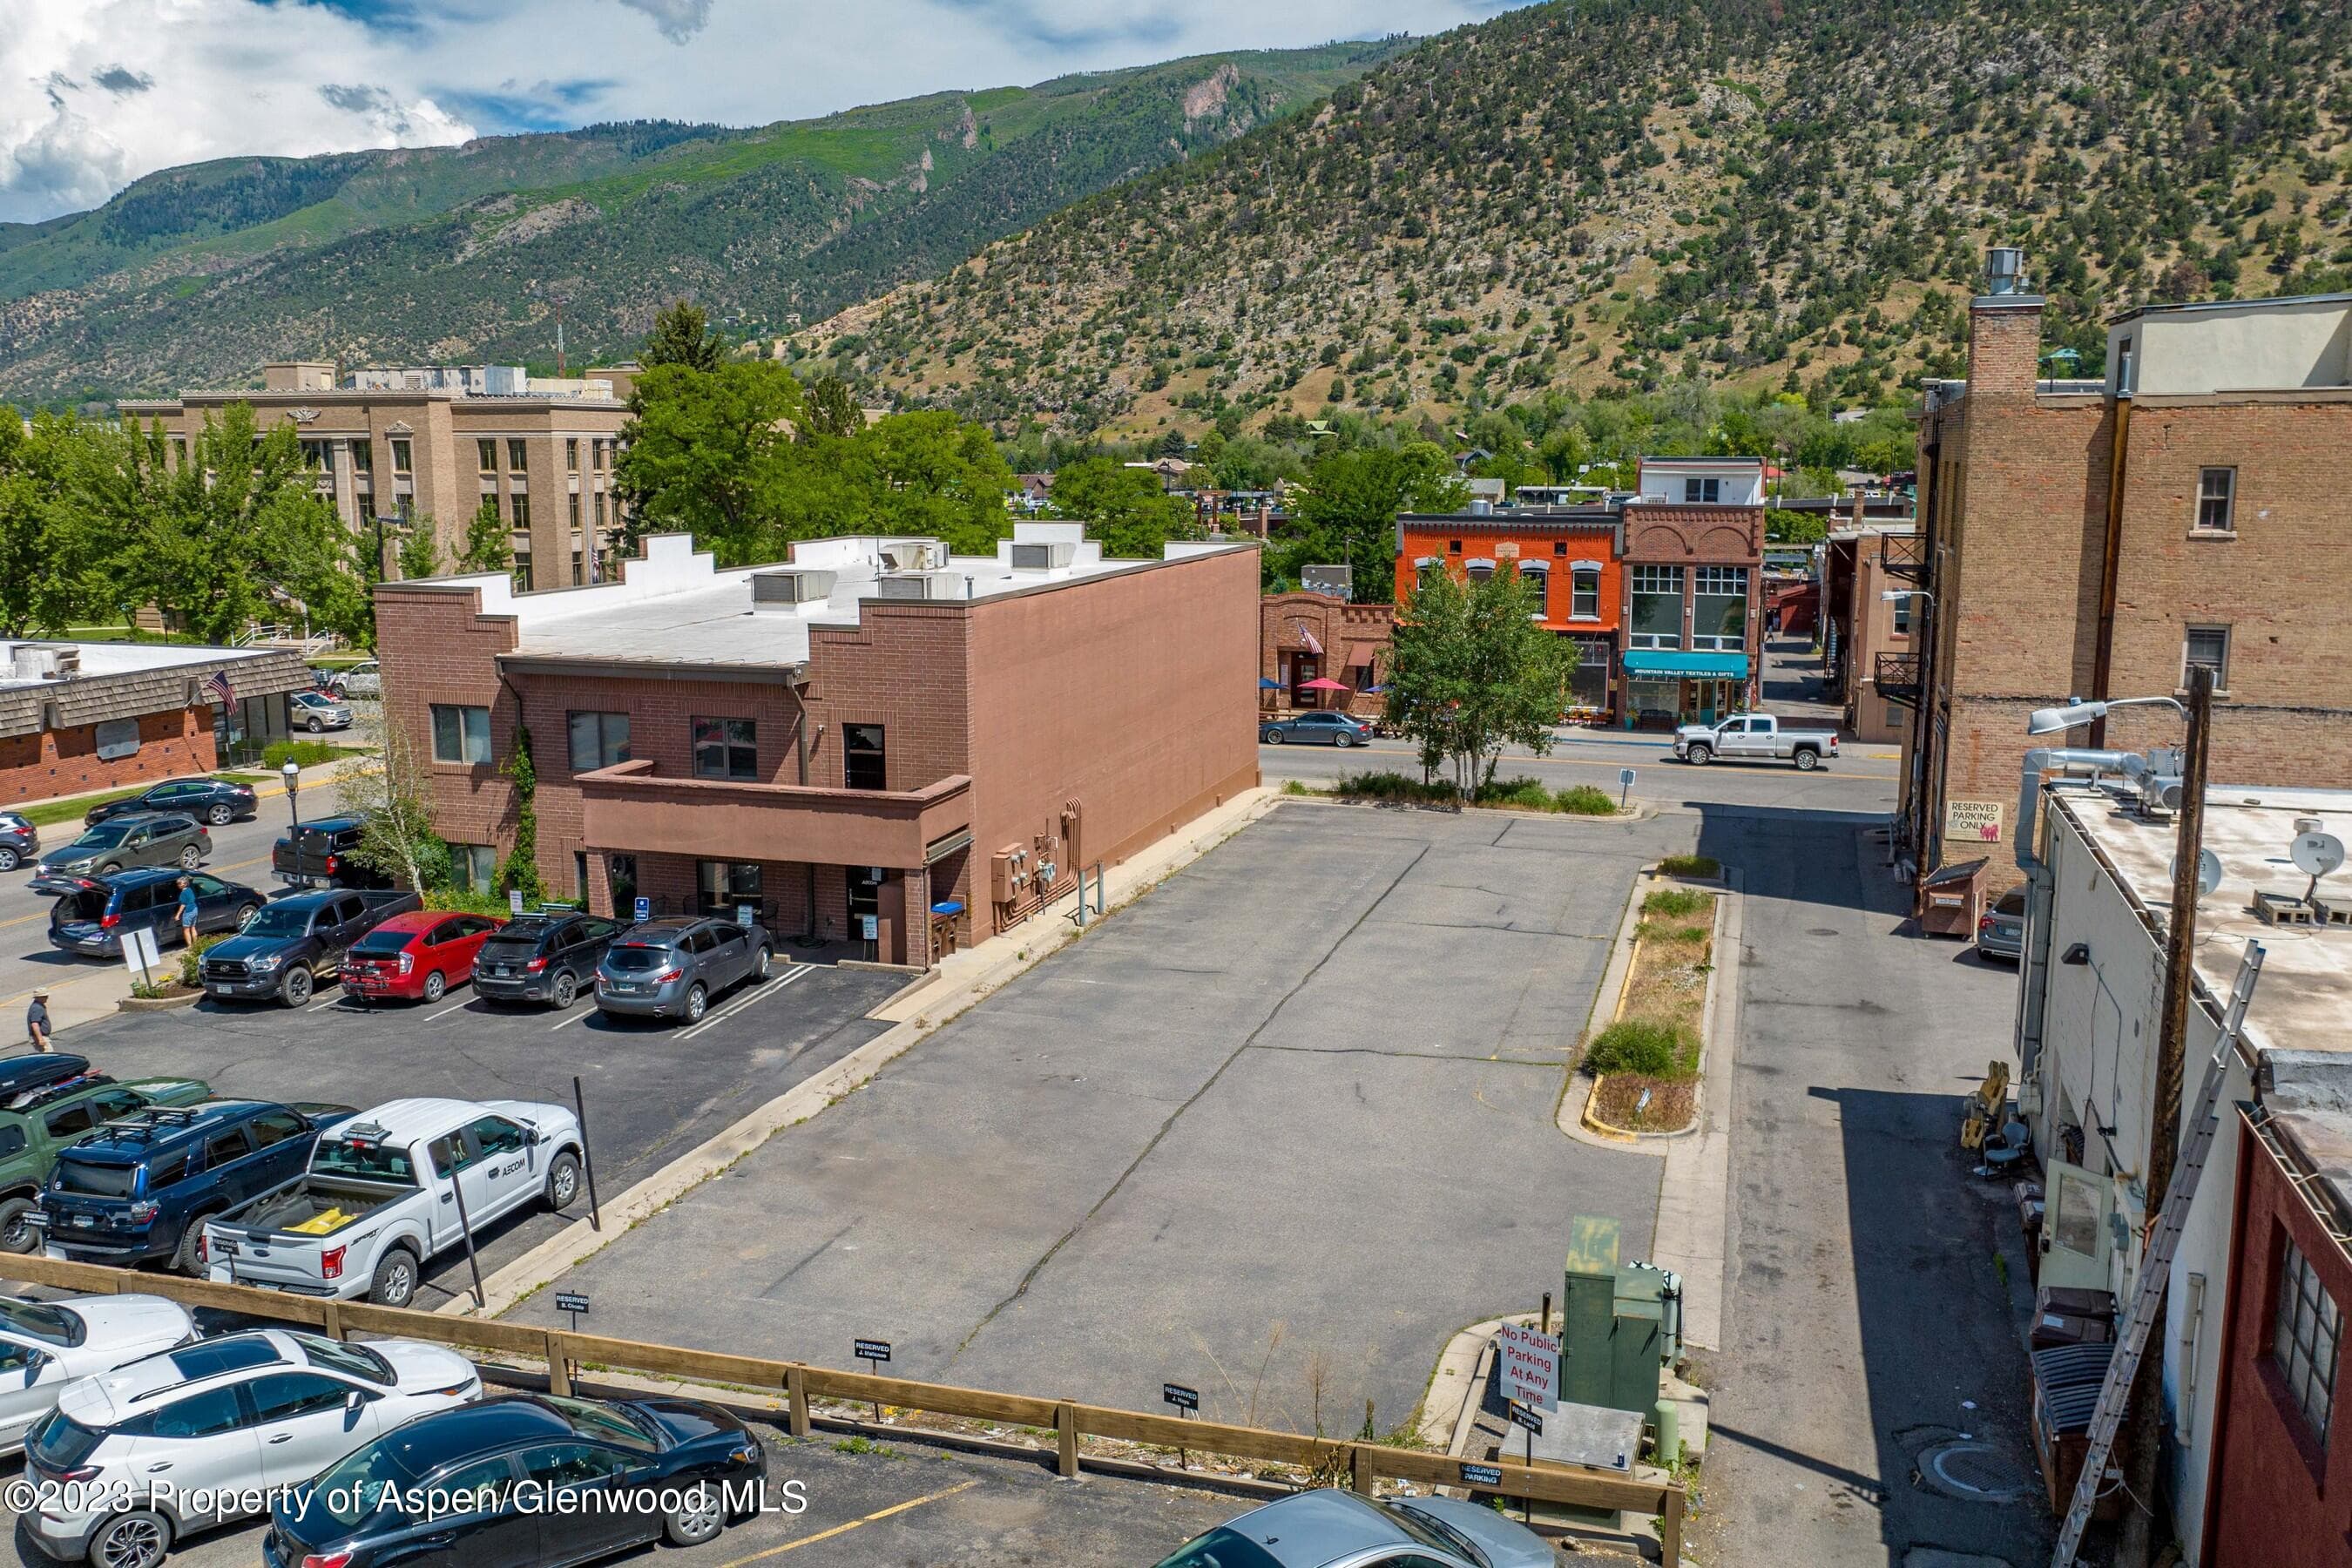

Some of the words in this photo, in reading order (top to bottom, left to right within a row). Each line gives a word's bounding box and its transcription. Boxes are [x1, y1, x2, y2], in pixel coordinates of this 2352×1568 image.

[1951, 802, 1998, 812] RESERVED
[1953, 811, 1996, 821] PARKING
[1960, 821, 1986, 830] ONLY
[503, 1158, 525, 1178] AECOM
[557, 1295, 588, 1304] RESERVED
[1502, 1326, 1517, 1341] No
[1521, 1331, 1558, 1353] Public
[855, 1342, 889, 1352] RESERVED
[1507, 1346, 1551, 1372] Parking
[1511, 1366, 1523, 1380] At
[1525, 1370, 1548, 1389] Any
[1165, 1387, 1197, 1400] RESERVED
[1516, 1385, 1543, 1404] Time
[1512, 1406, 1542, 1426] RESERVED
[1461, 1464, 1501, 1477] RESERVED
[1464, 1473, 1497, 1484] PARKING
